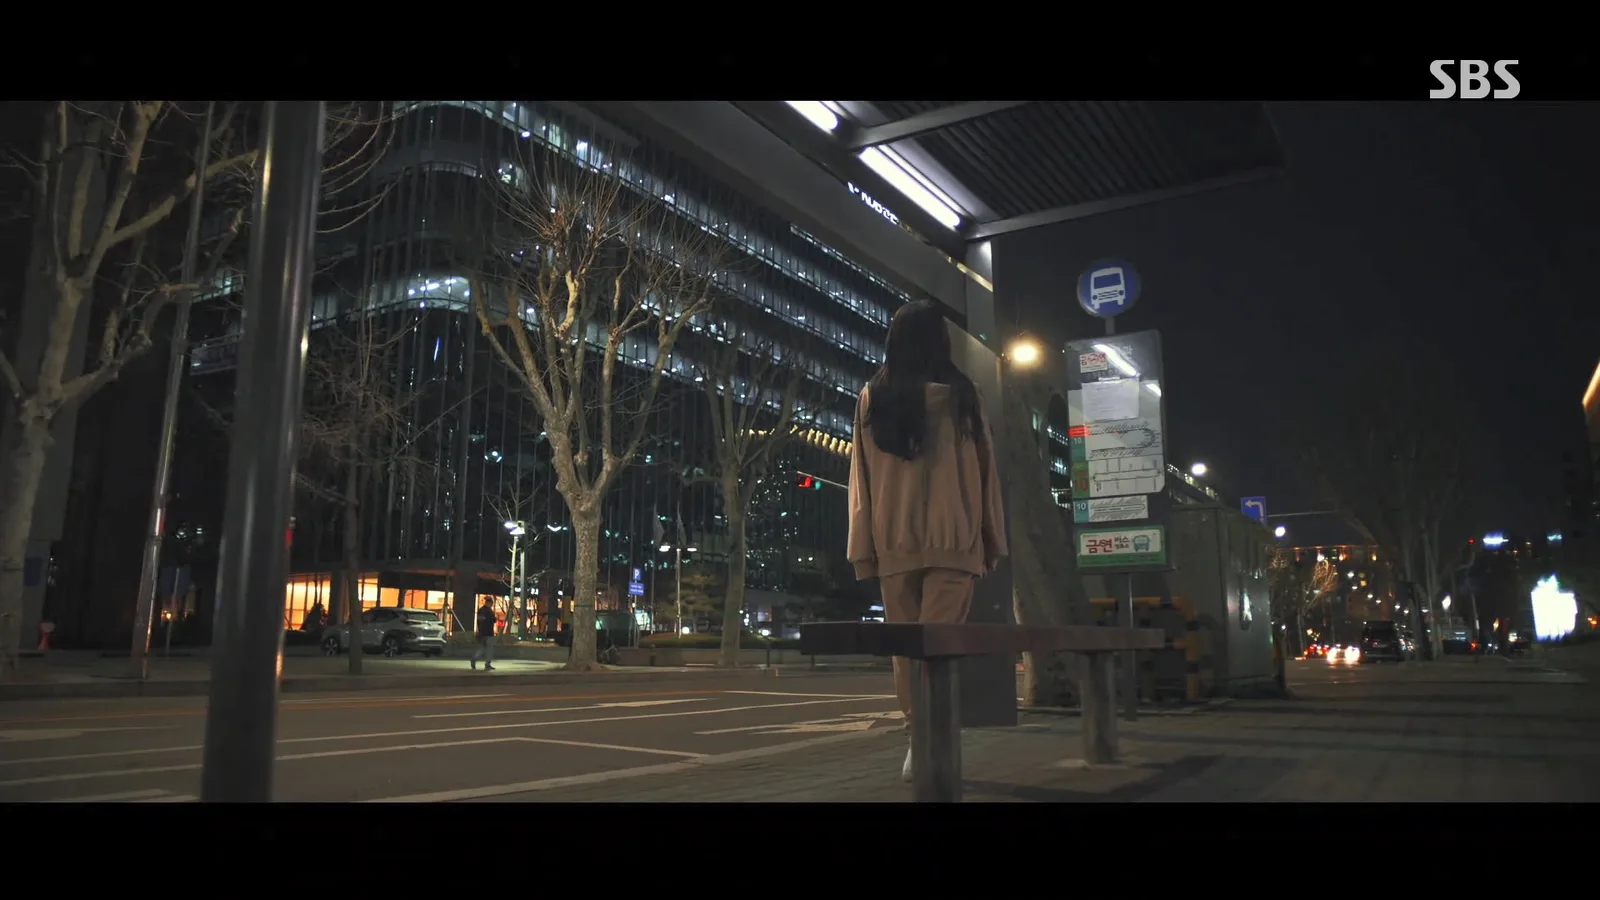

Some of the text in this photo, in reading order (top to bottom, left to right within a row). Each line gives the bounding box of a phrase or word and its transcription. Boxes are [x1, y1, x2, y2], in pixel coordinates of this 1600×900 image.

[1076, 502, 1087, 511] 10
[1086, 538, 1113, 554] 금연
[1114, 536, 1130, 544] 버스
